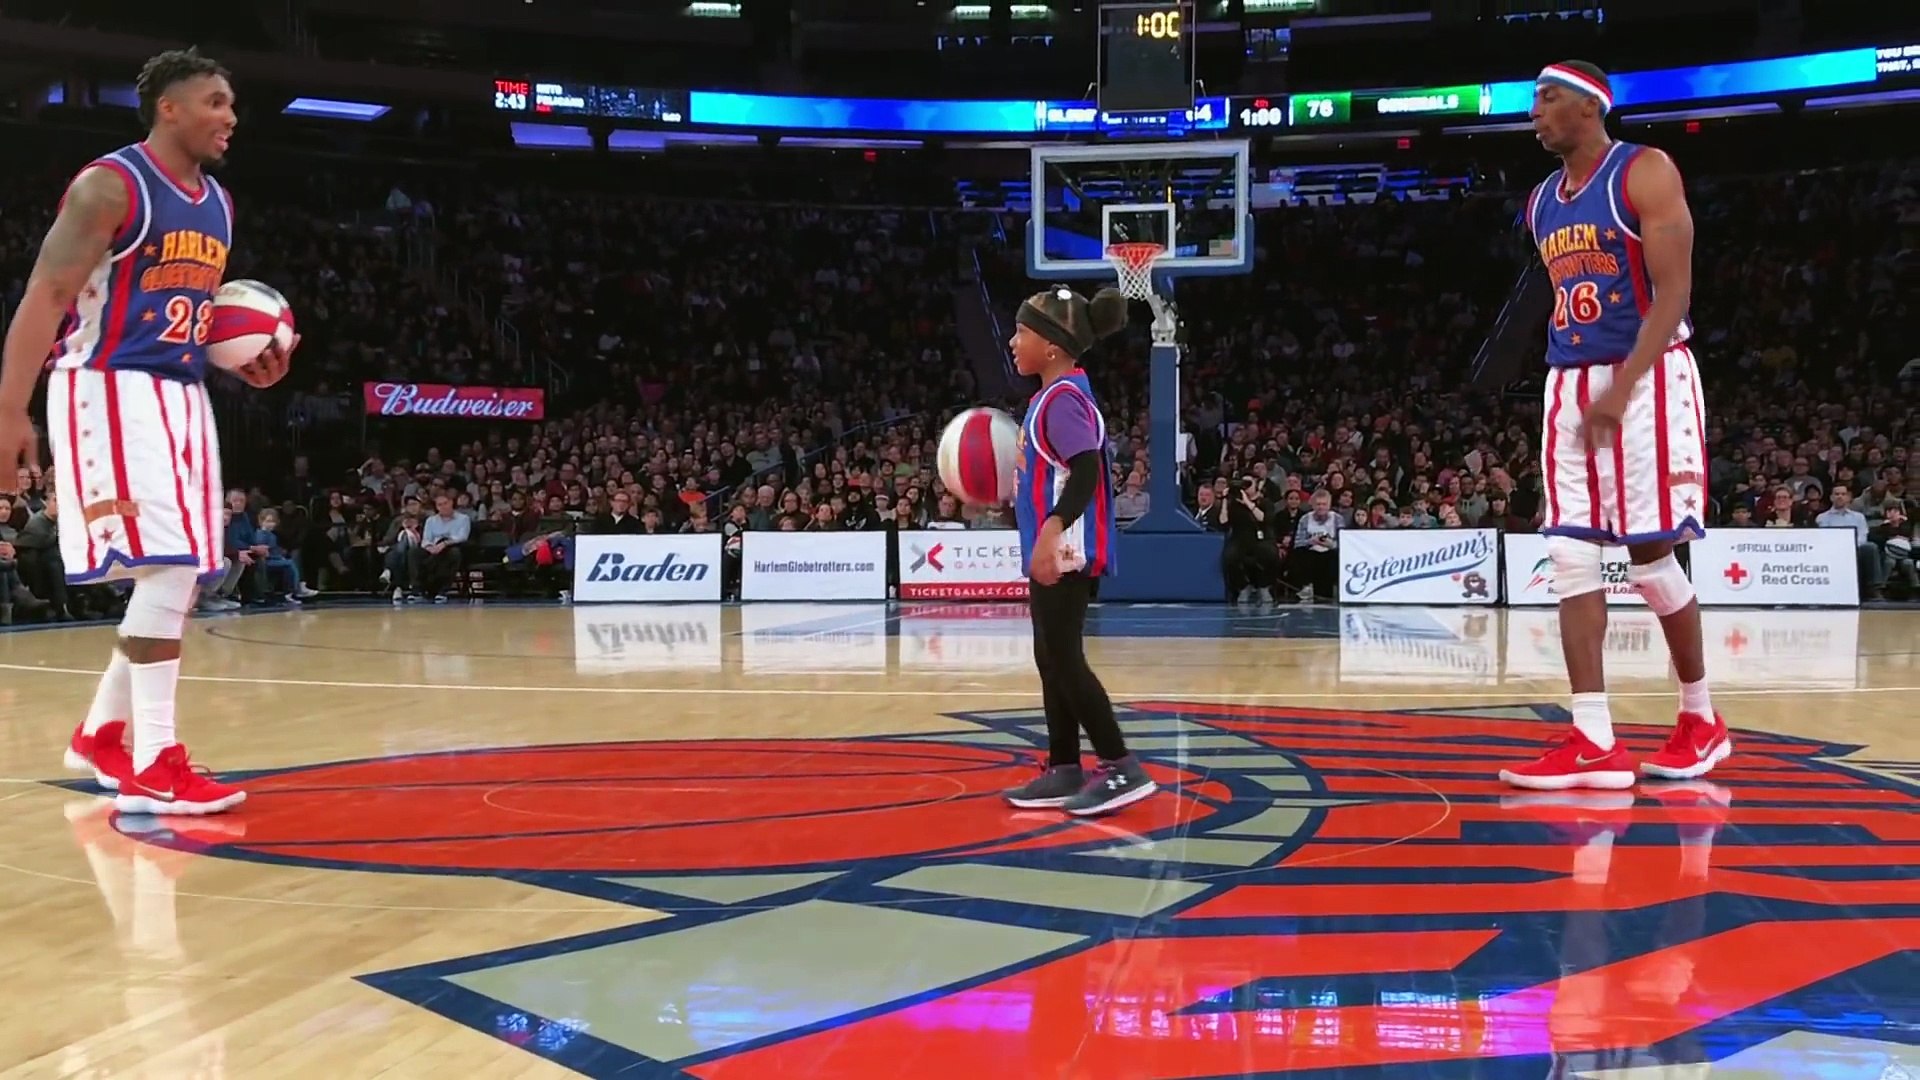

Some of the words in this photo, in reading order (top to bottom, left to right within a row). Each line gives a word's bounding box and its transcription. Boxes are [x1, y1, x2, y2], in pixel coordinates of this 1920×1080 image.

[494, 80, 528, 95] TIME
[495, 92, 526, 110] 2:43
[1306, 98, 1334, 118] 76
[1240, 107, 1282, 126] 1:00
[156, 295, 213, 346] 28
[374, 383, 533, 416] Budweiser
[953, 547, 1021, 558] TICKE
[1736, 543, 1773, 553] OFFICIAL
[1774, 543, 1808, 553] CHARITY
[586, 552, 708, 582] Baden
[753, 560, 875, 573] HarlemGlobetrotters.com
[1345, 531, 1490, 596] Entenmann's
[1761, 562, 1830, 574] American
[1761, 574, 1789, 585] Red
[1790, 574, 1831, 586] Cross
